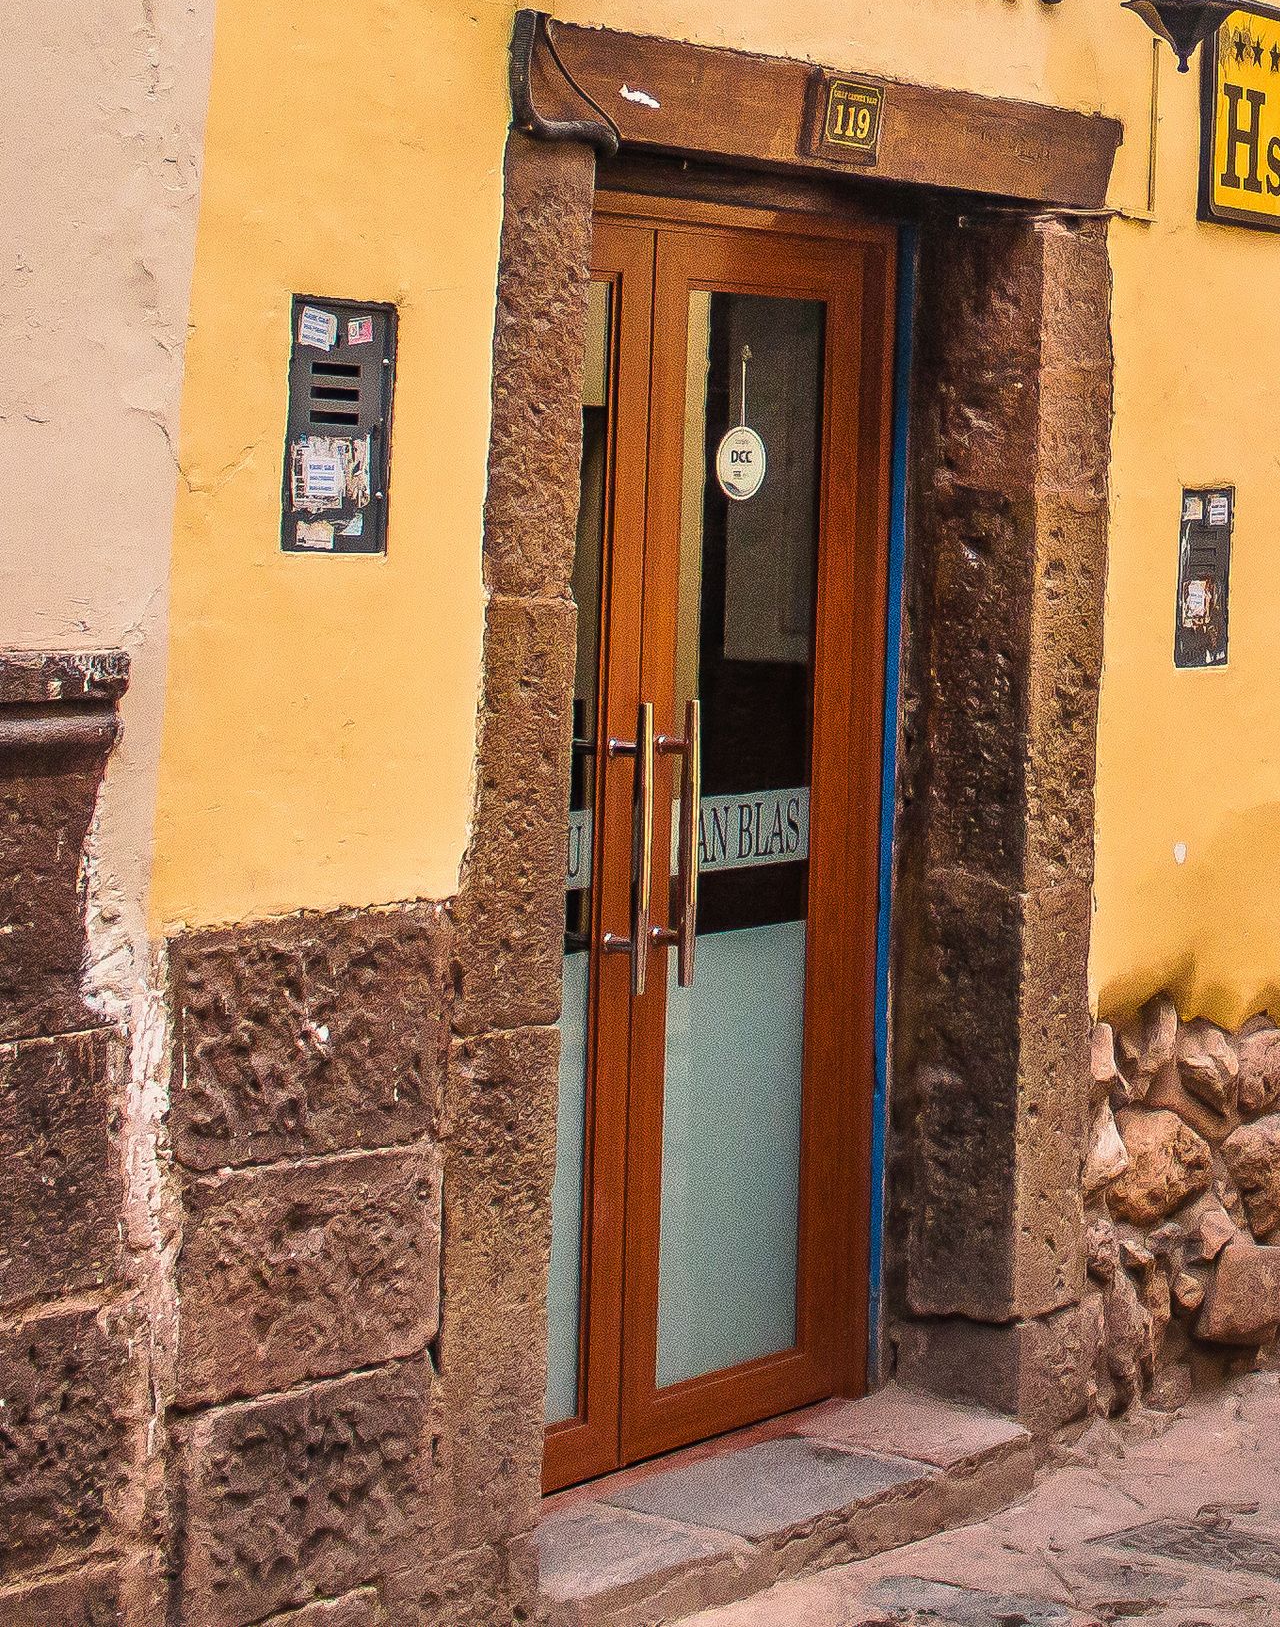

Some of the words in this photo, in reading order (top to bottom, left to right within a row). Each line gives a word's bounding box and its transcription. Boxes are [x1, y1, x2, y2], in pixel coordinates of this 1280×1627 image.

[833, 104, 871, 139] 119
[730, 449, 753, 464] DCC
[698, 804, 732, 864] AN
[736, 797, 801, 860] BLAS
